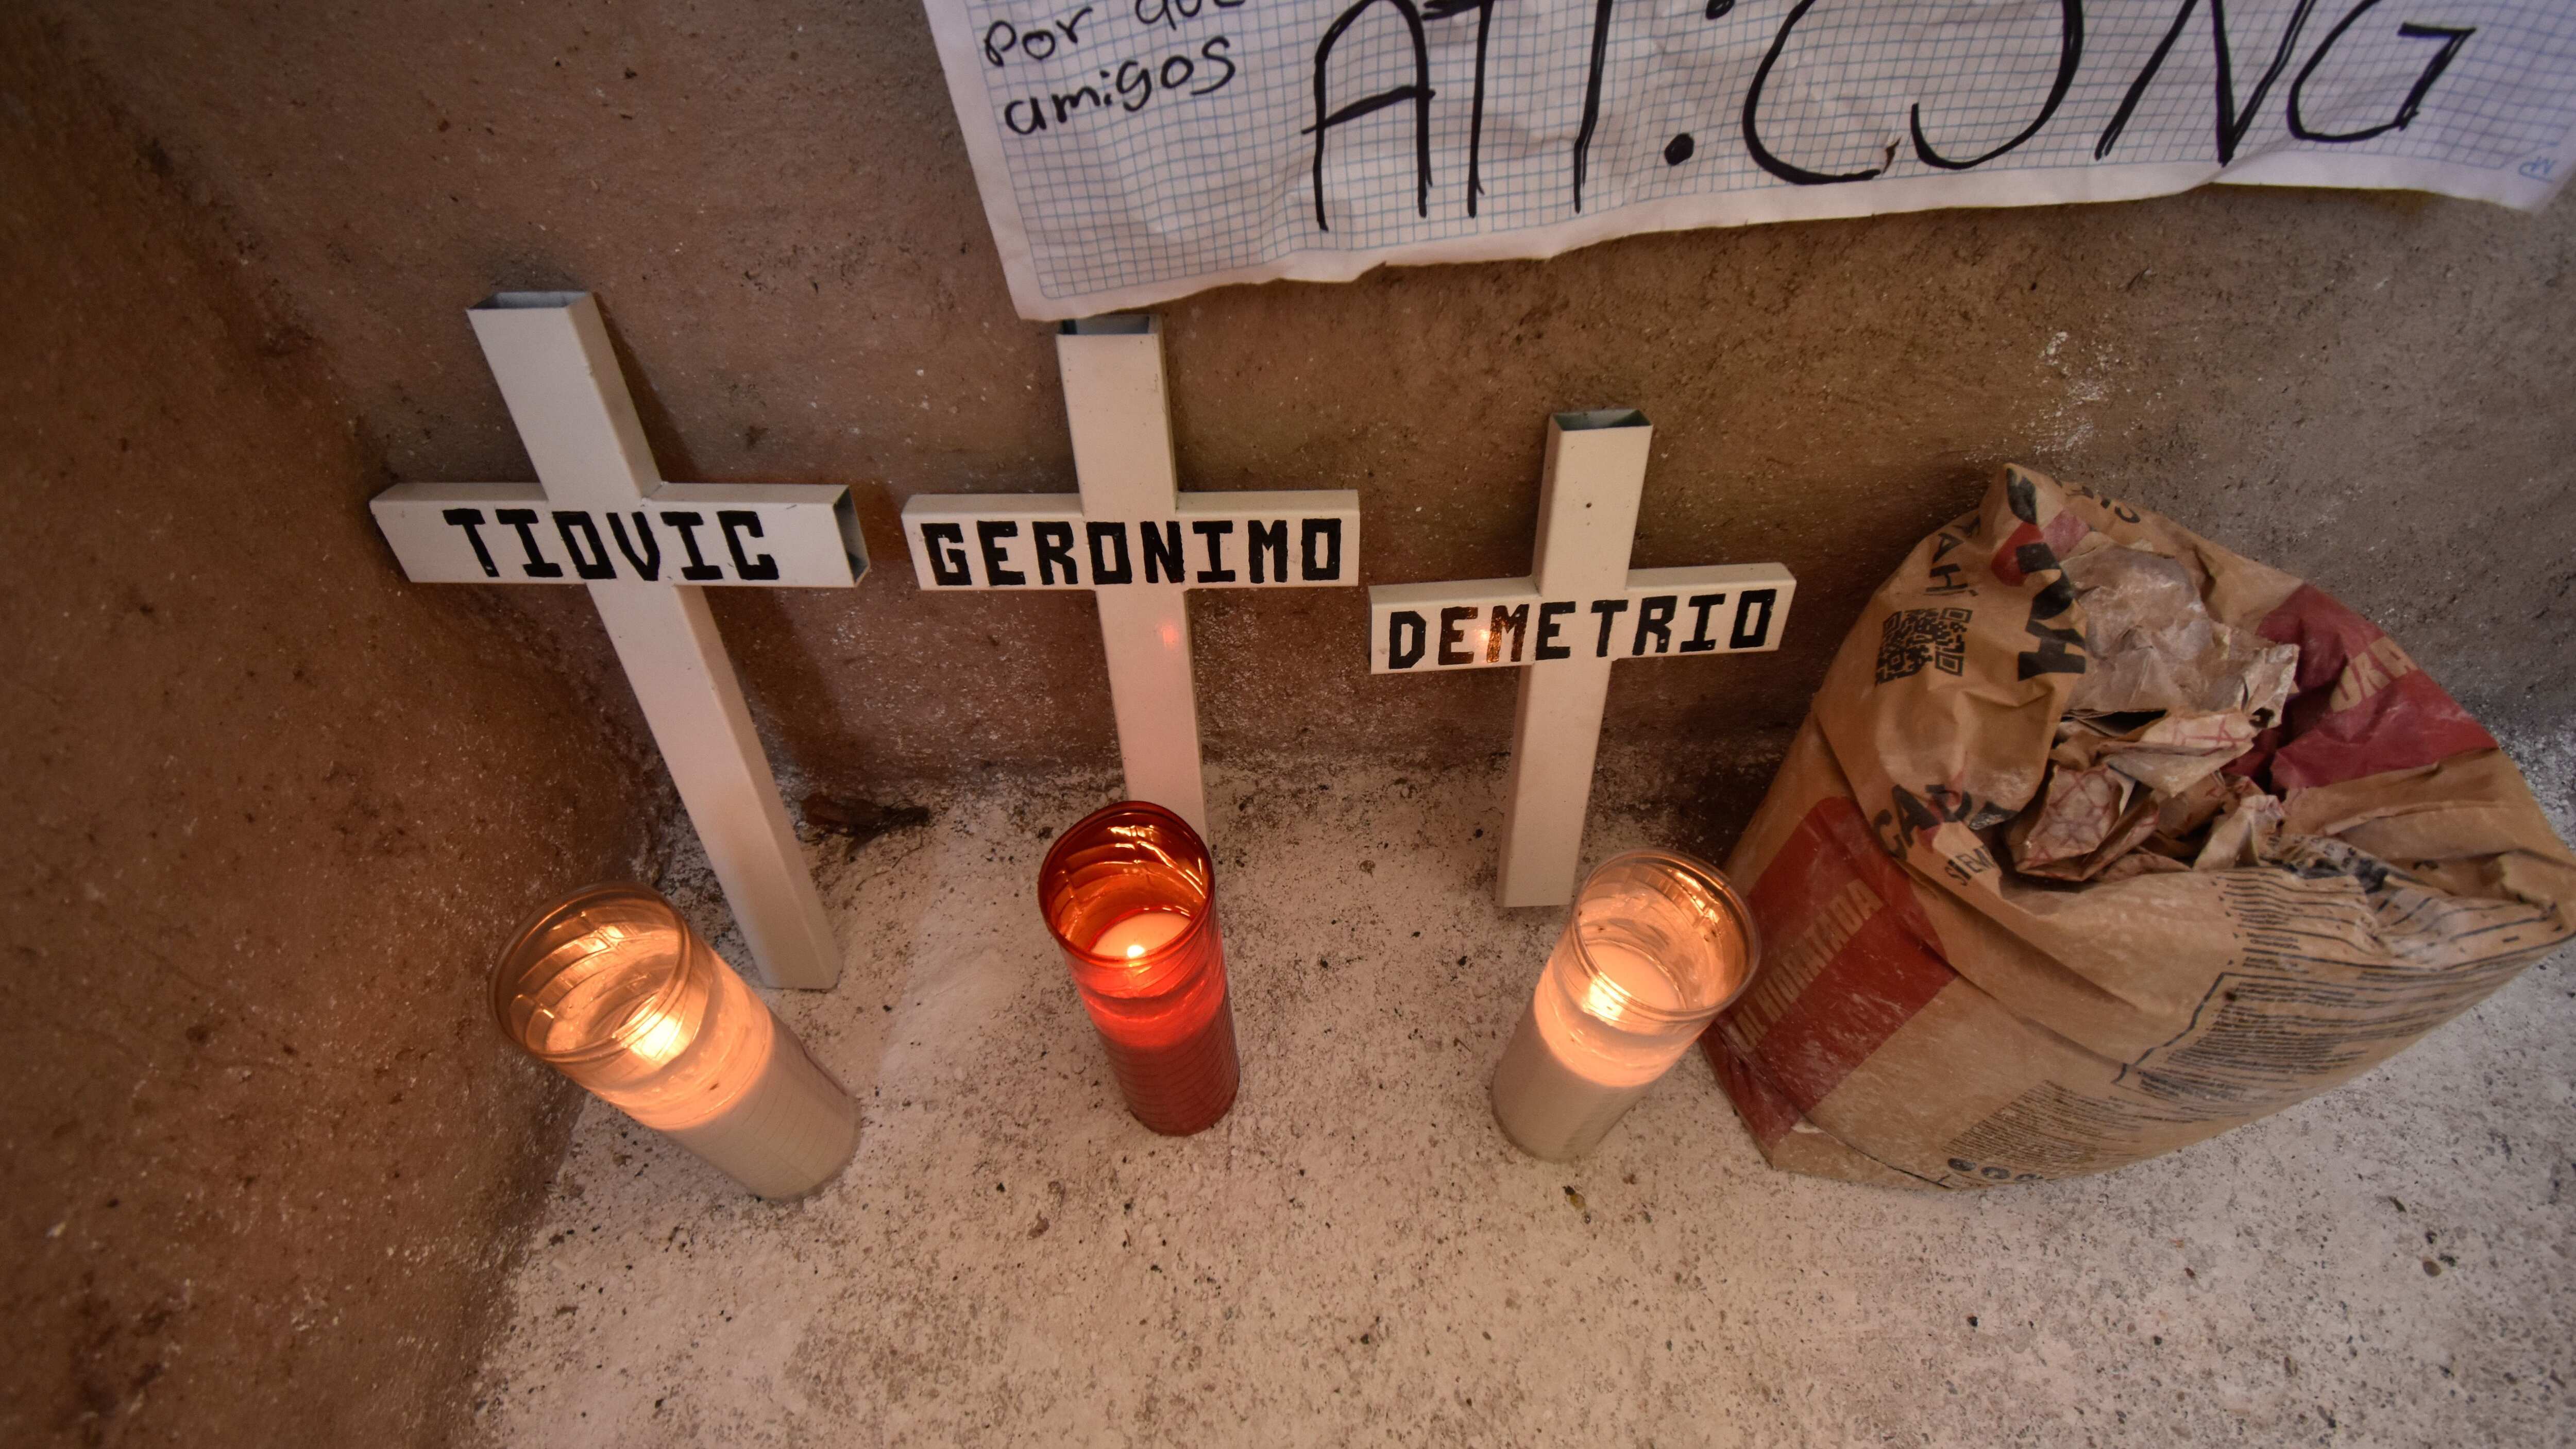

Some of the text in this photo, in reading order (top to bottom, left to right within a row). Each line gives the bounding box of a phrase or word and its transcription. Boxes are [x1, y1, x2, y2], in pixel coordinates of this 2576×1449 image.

[984, 0, 1246, 67] Por qu
[1004, 36, 1235, 134] amigos
[442, 508, 779, 582] TIOVIC
[921, 518, 1342, 586] GERONIMO
[1388, 588, 1777, 670] DEMETRIO
